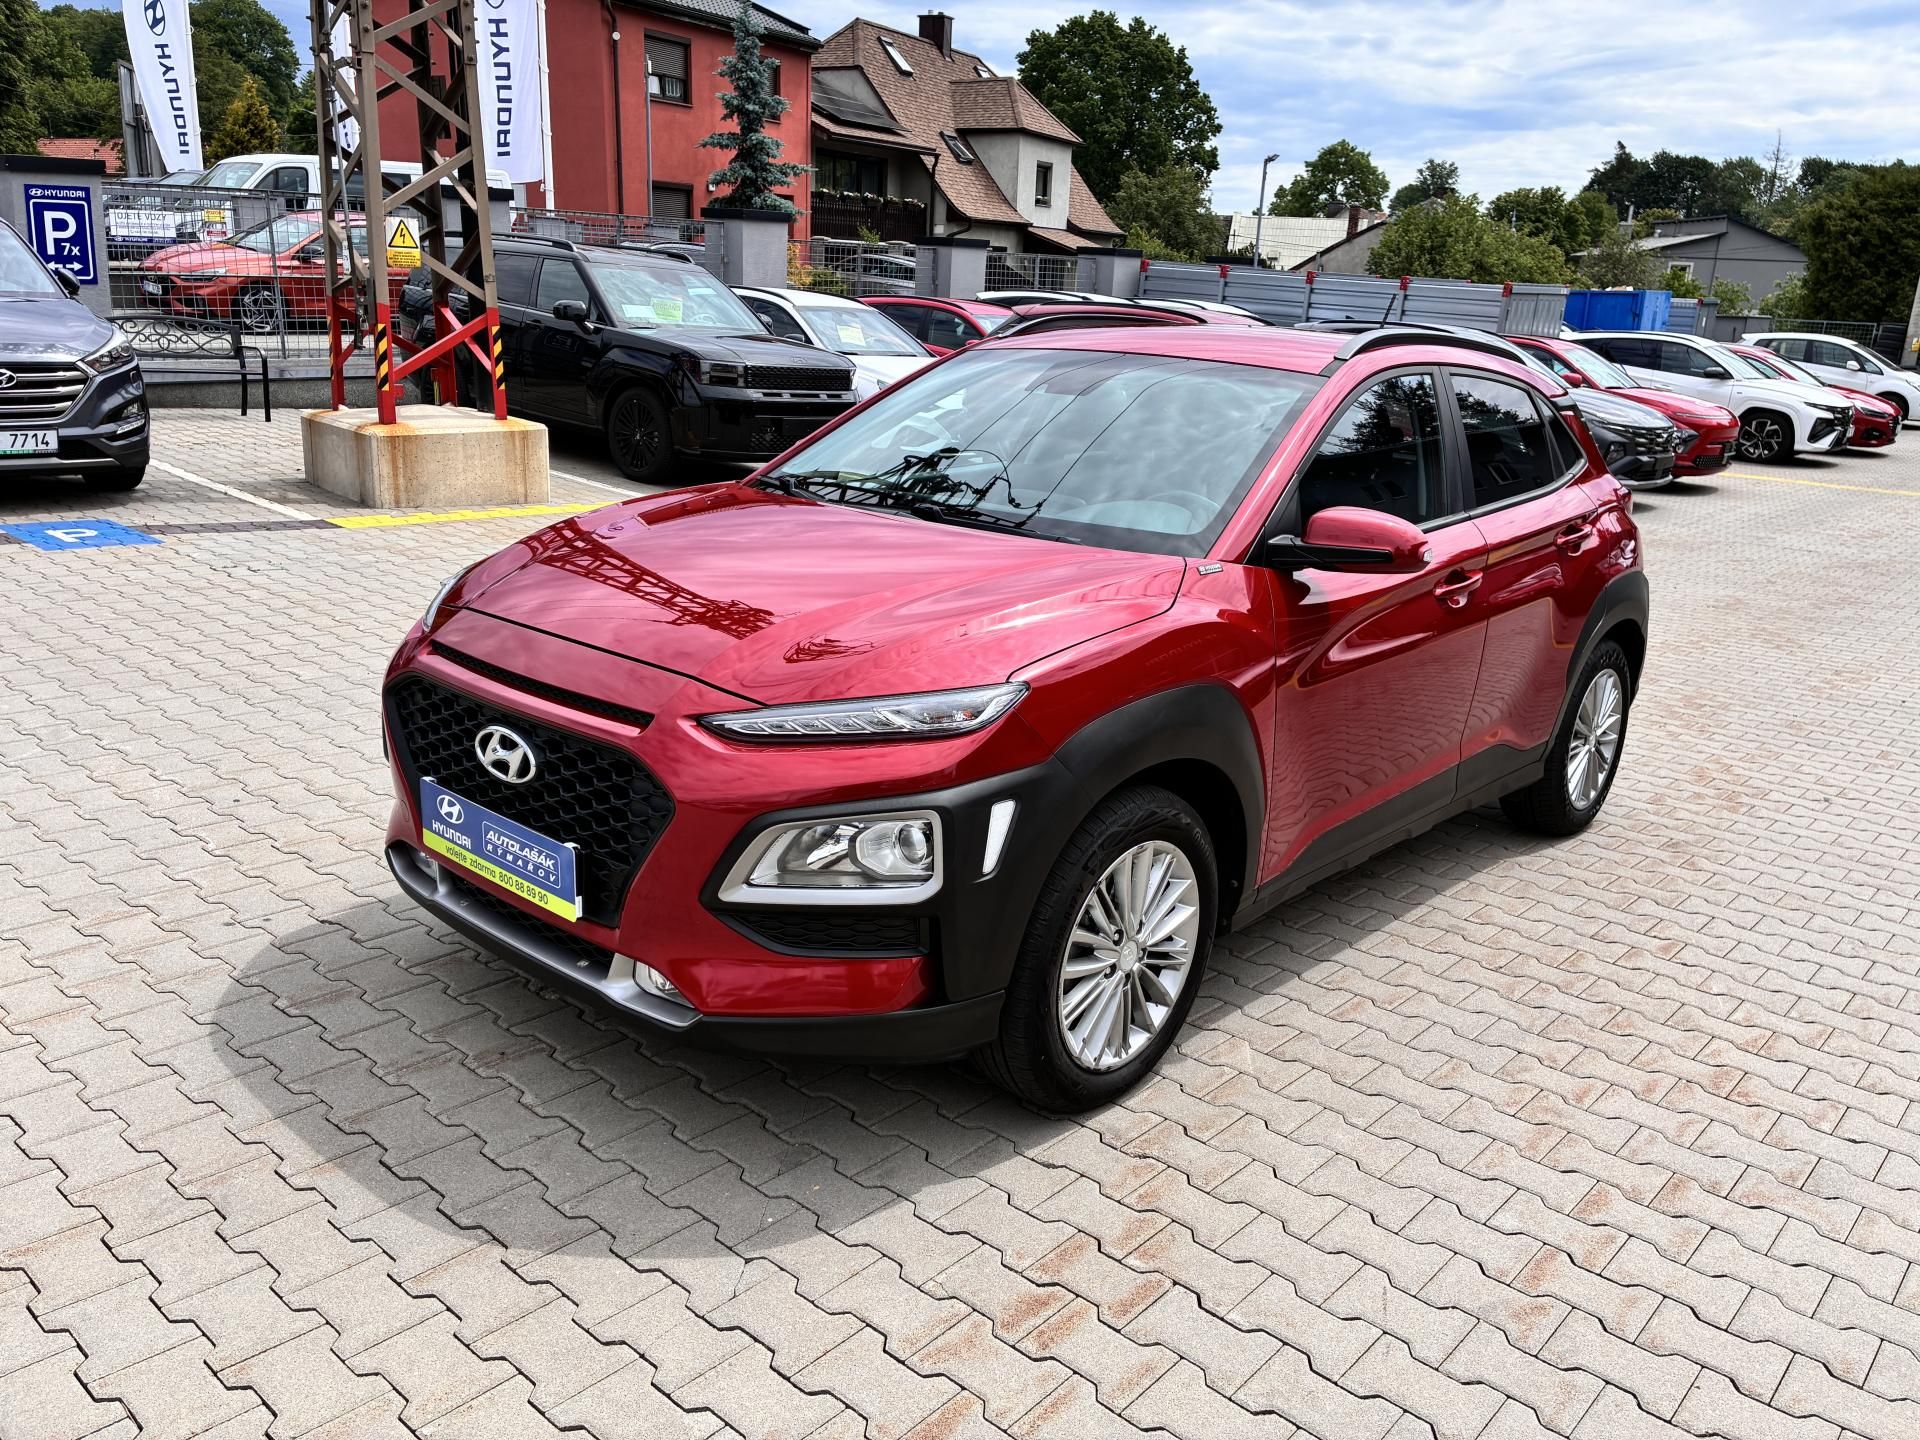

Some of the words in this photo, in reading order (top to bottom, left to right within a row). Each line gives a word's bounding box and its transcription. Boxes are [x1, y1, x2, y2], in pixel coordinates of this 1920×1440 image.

[44, 189, 86, 198] HYUNDAI
[43, 210, 77, 255] P
[60, 242, 81, 256] 7x
[9, 433, 50, 448] 7714
[432, 819, 472, 850] HYUNDAI
[486, 830, 555, 870] AUTOLAŠÁK
[445, 845, 468, 863] volejte
[469, 858, 496, 878] zdarma
[498, 871, 514, 887] 800
[515, 879, 525, 893] 88
[526, 885, 537, 899] 89
[537, 891, 549, 905] 90
